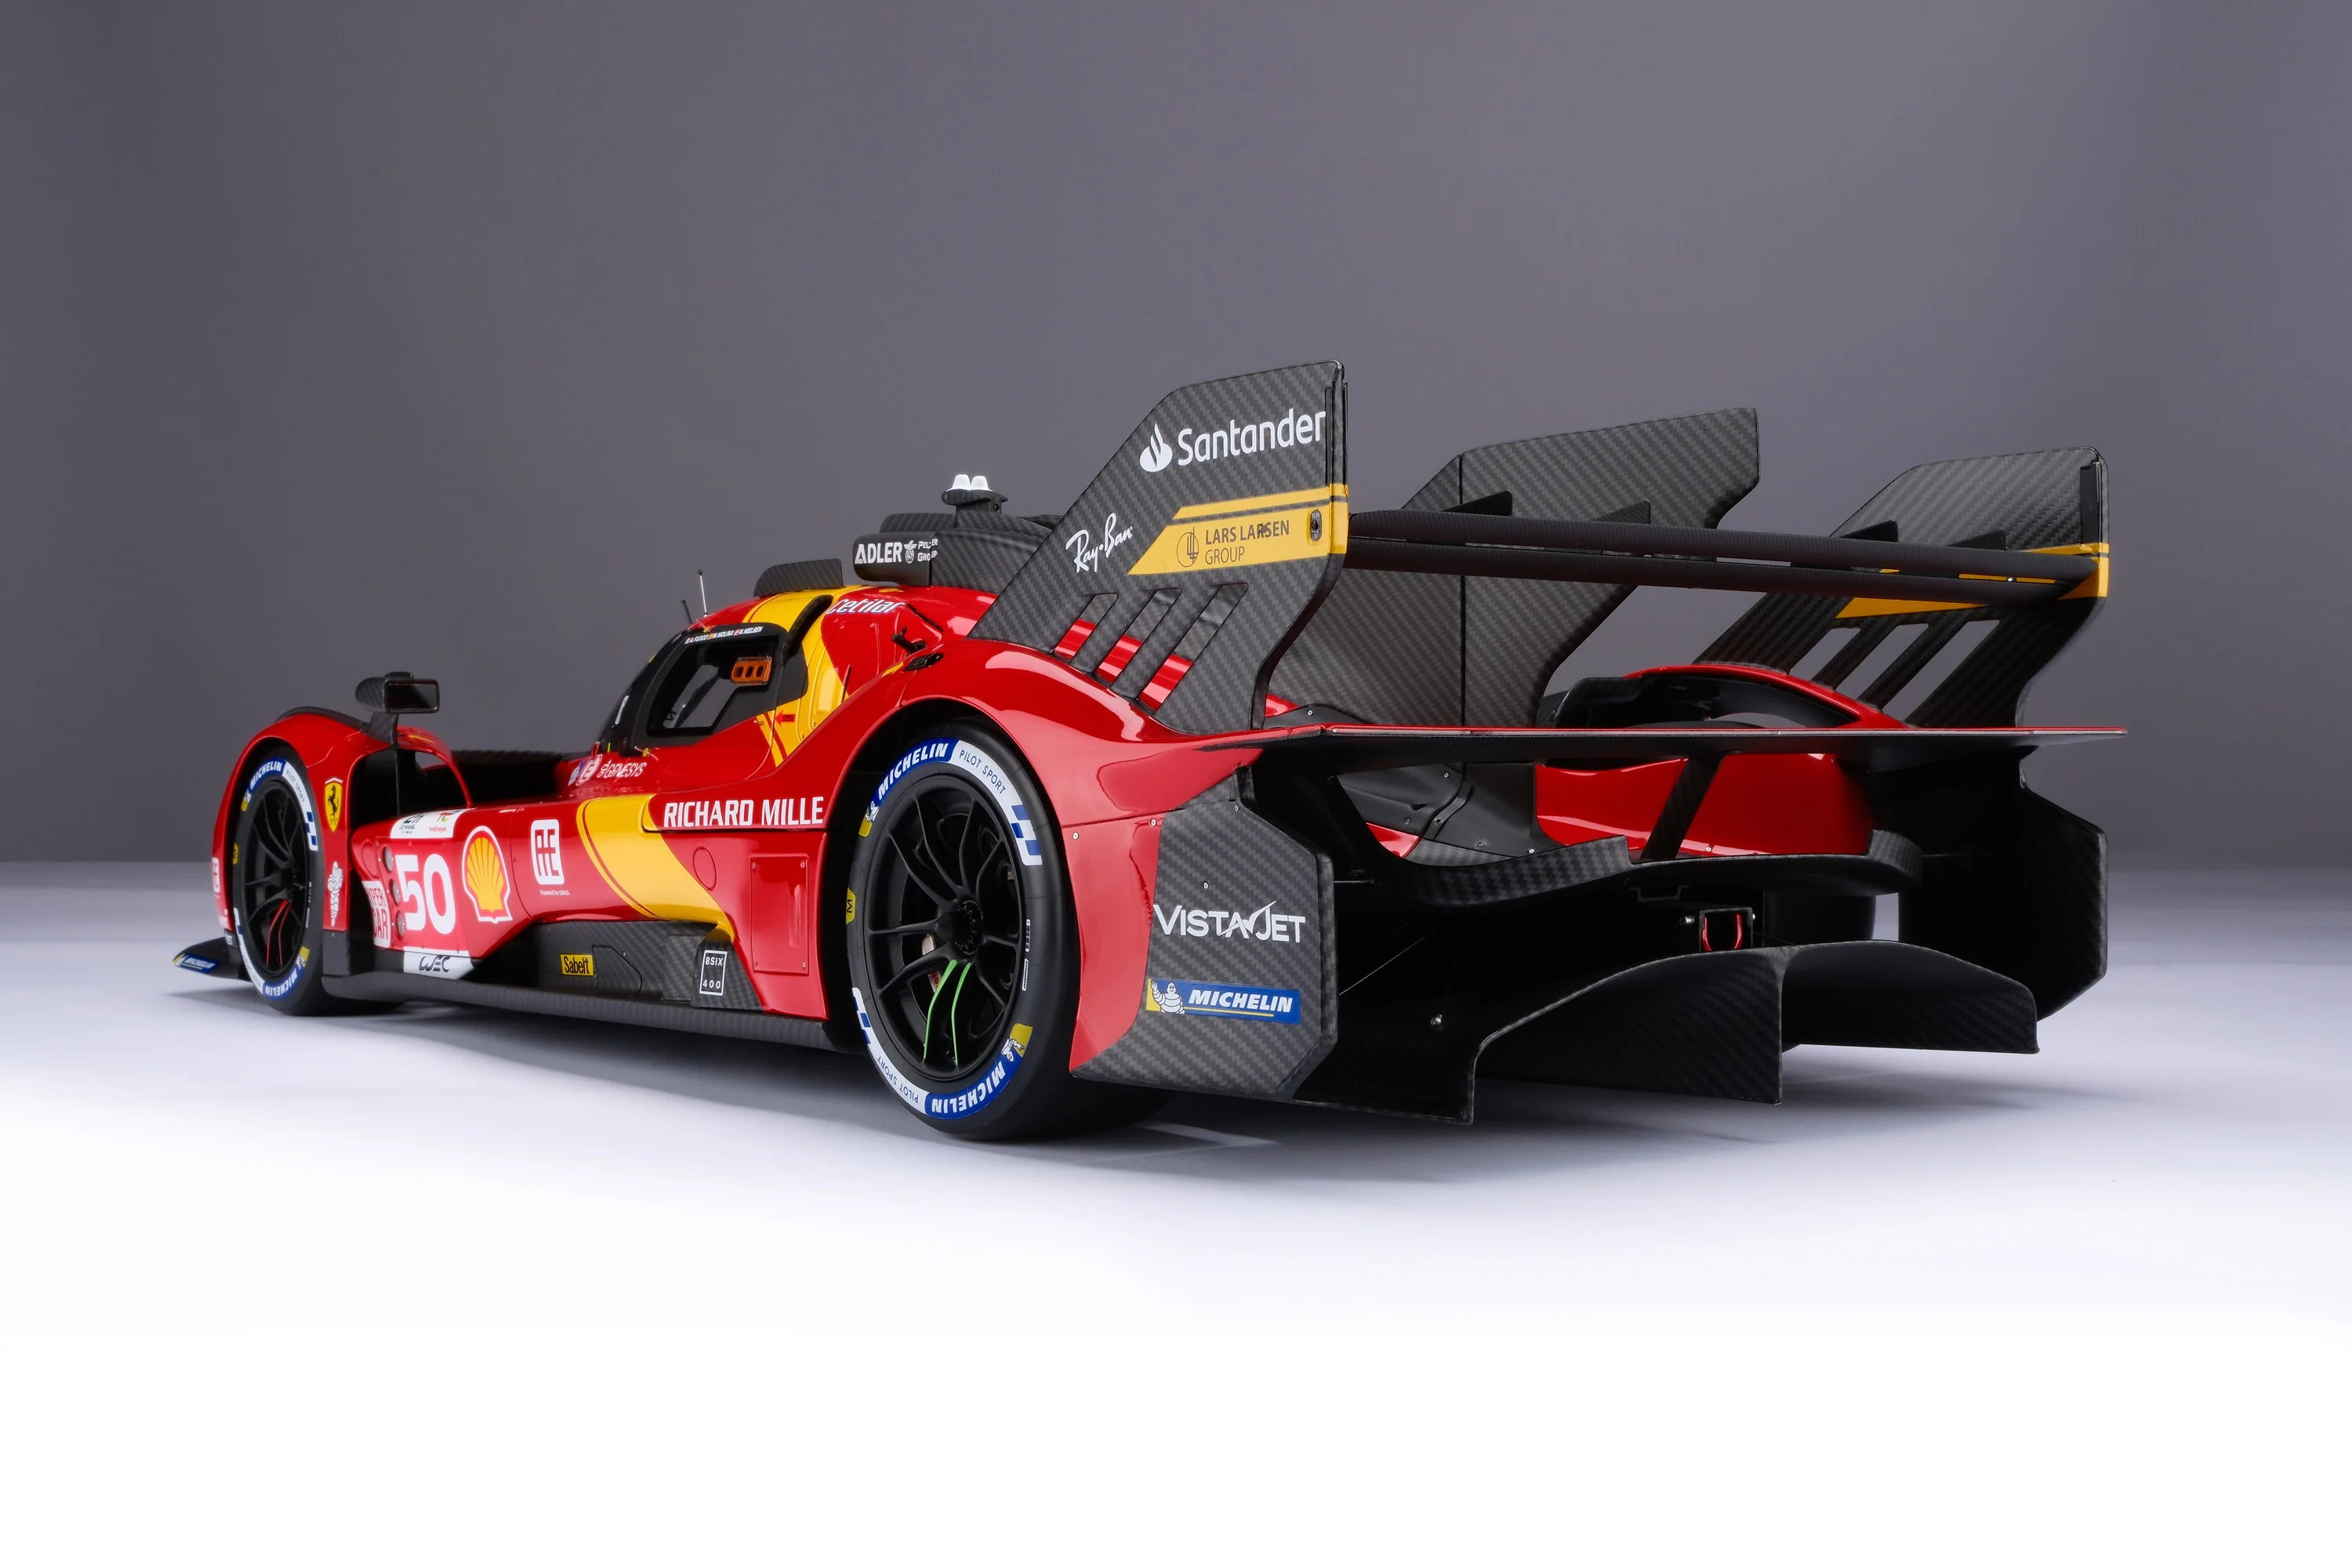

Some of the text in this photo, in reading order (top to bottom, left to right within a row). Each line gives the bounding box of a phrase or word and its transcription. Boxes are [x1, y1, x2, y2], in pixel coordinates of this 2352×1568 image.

[1178, 408, 1326, 466] Santander
[1205, 520, 1290, 545] LARS LARSEN
[855, 542, 902, 564] ADLER
[1205, 546, 1245, 564] GROUP
[826, 598, 906, 615] Cetilar
[250, 760, 283, 790] MICHELIN
[878, 742, 1007, 800] MICHELIN PILOT SPORT
[664, 796, 824, 827] RICHARD MILLE
[366, 887, 387, 906] YPER
[395, 854, 456, 935] 50
[847, 899, 852, 913] M
[419, 955, 452, 973] WEC
[564, 956, 590, 975] Sabelt
[266, 968, 298, 996] MICHELIN
[702, 979, 721, 989] 400
[1189, 989, 1293, 1012] MICHELIN
[877, 1056, 1006, 1113] MICHELIN PILOT SPORT
